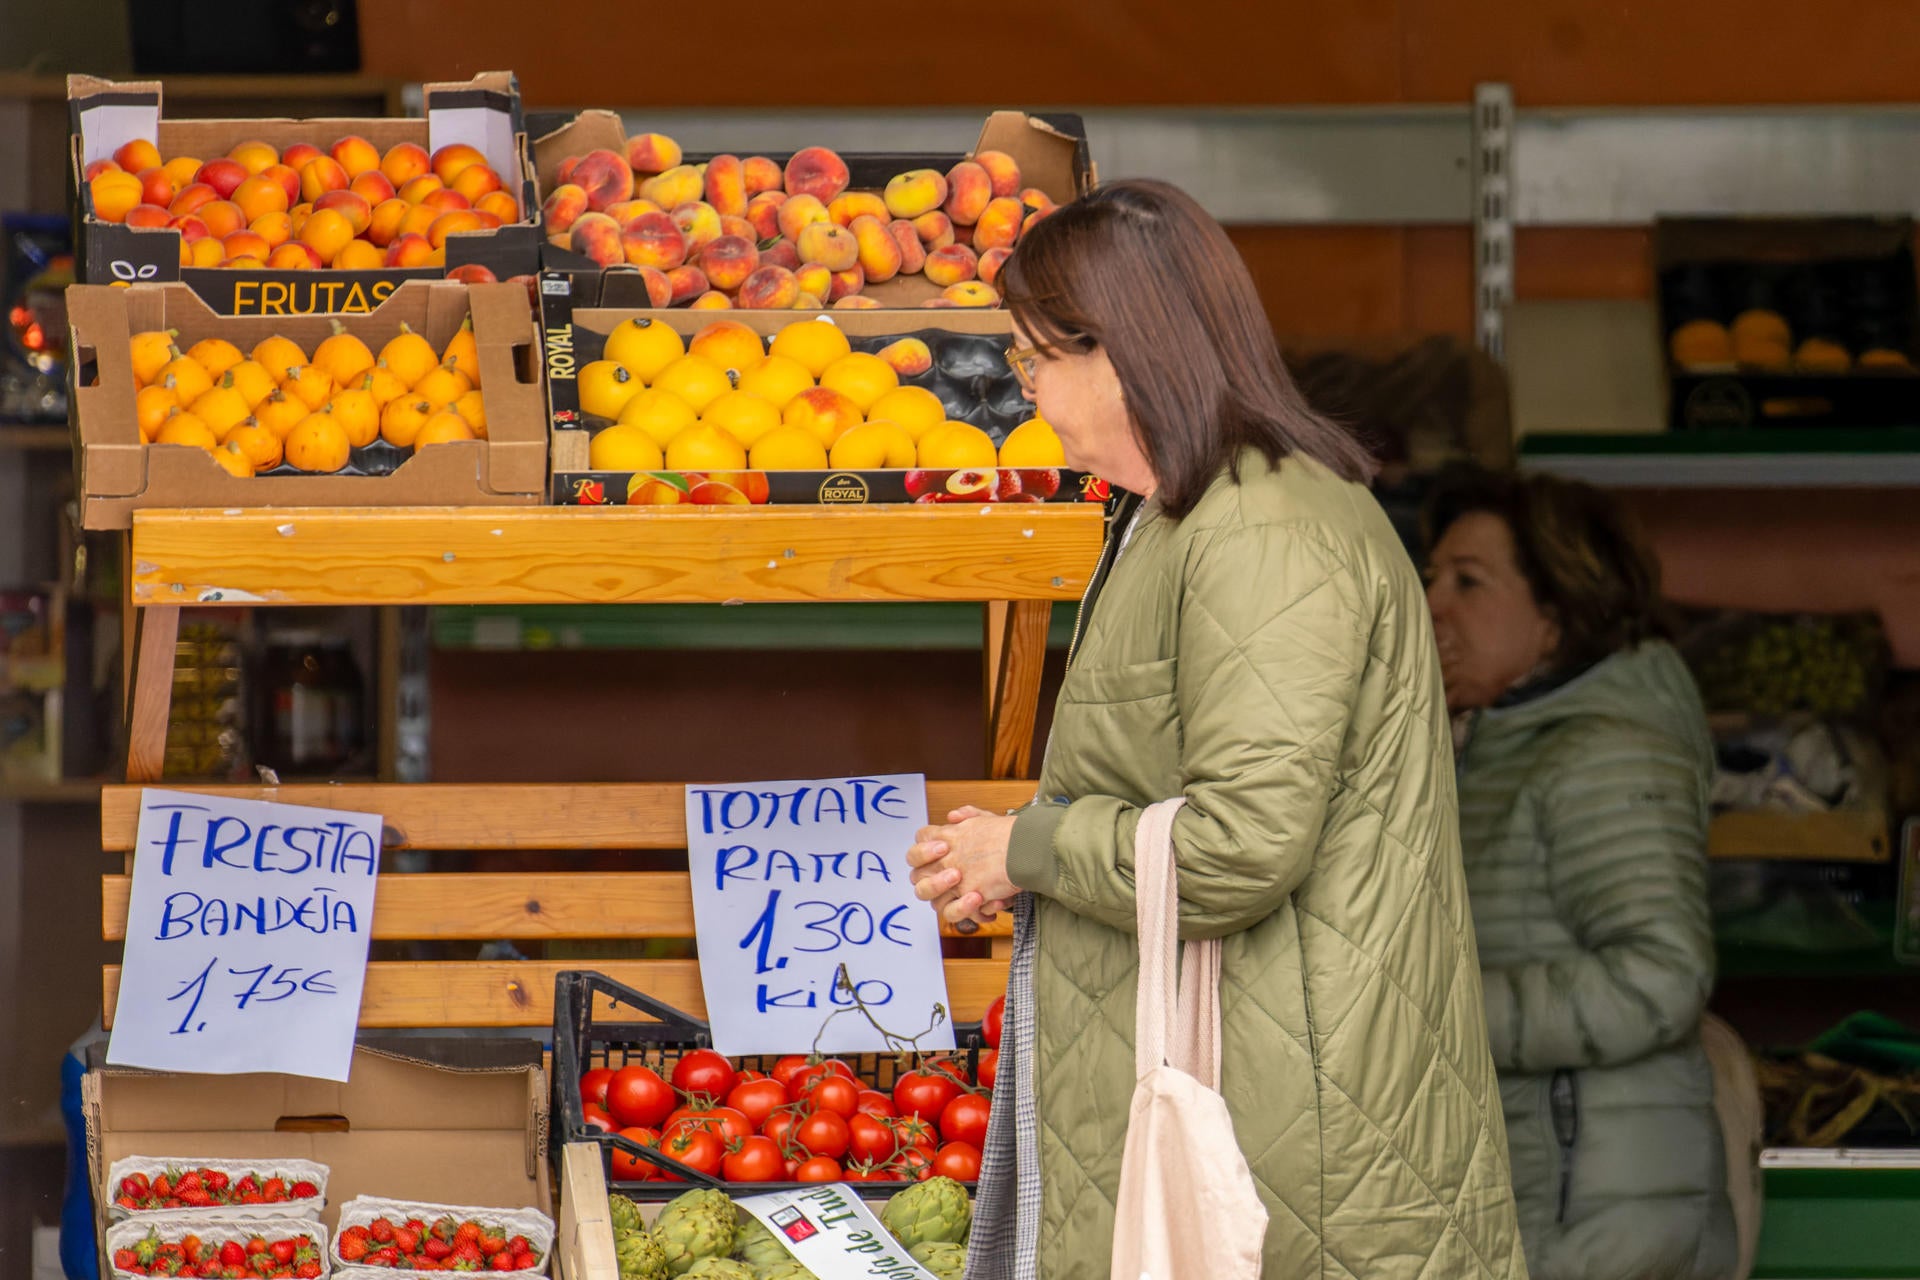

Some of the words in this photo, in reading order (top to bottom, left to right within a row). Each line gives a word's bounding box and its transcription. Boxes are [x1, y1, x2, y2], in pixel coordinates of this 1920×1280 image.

[545, 323, 576, 379] ROYAL
[573, 478, 608, 504] R
[824, 490, 864, 499] ROYAL
[1079, 474, 1114, 499] R
[691, 779, 909, 834] TOMATE
[147, 804, 375, 876] FRESITA
[715, 844, 891, 891] RAMA
[155, 887, 357, 941] BANDEJA
[845, 1229, 884, 1254] de
